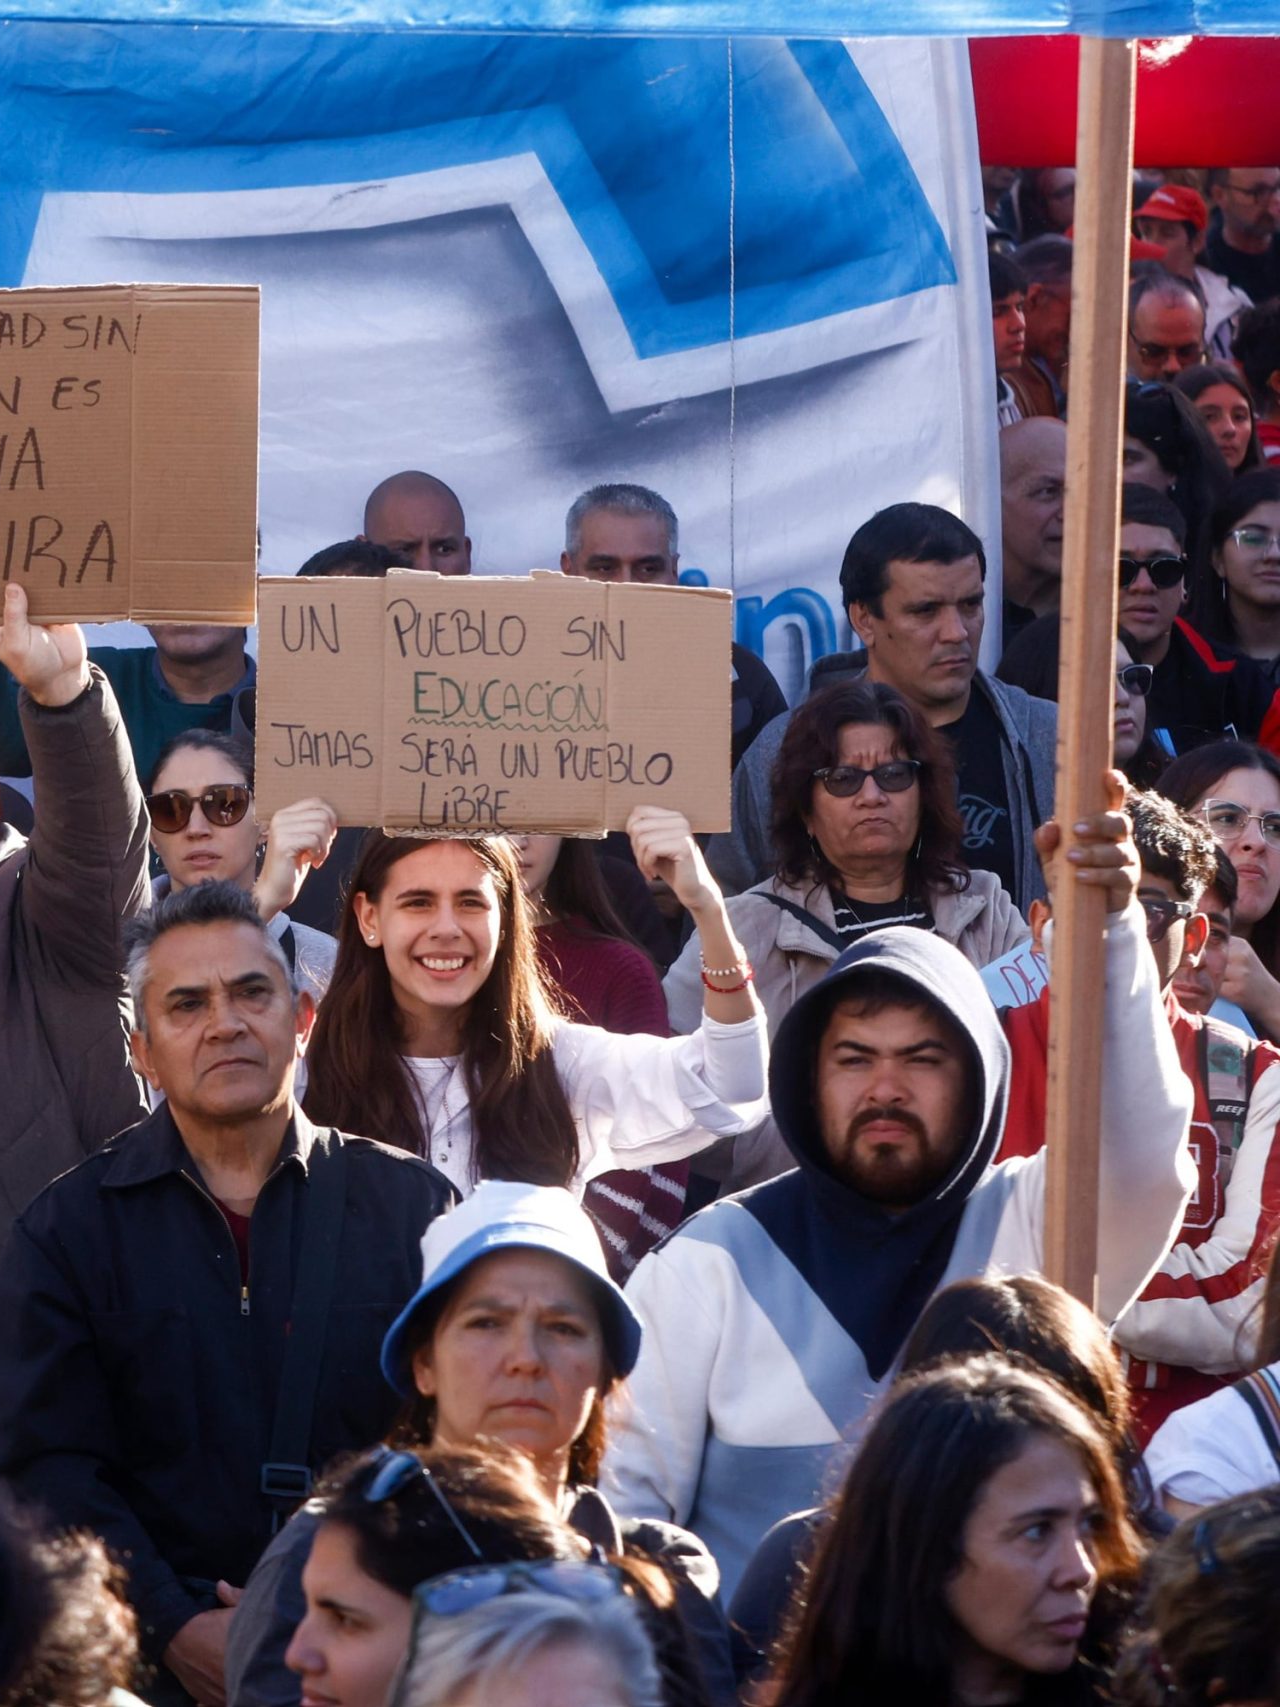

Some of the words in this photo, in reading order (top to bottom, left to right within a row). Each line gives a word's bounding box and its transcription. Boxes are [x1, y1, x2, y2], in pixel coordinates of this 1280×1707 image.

[63, 313, 142, 355] SIN
[51, 376, 102, 411] ES
[281, 603, 340, 654] UN
[386, 598, 527, 658] PUEBLO
[270, 723, 374, 769] JAMAS
[499, 741, 539, 778] UN
[554, 738, 673, 786] PUEBLO
[1215, 1103, 1247, 1117] REEF
